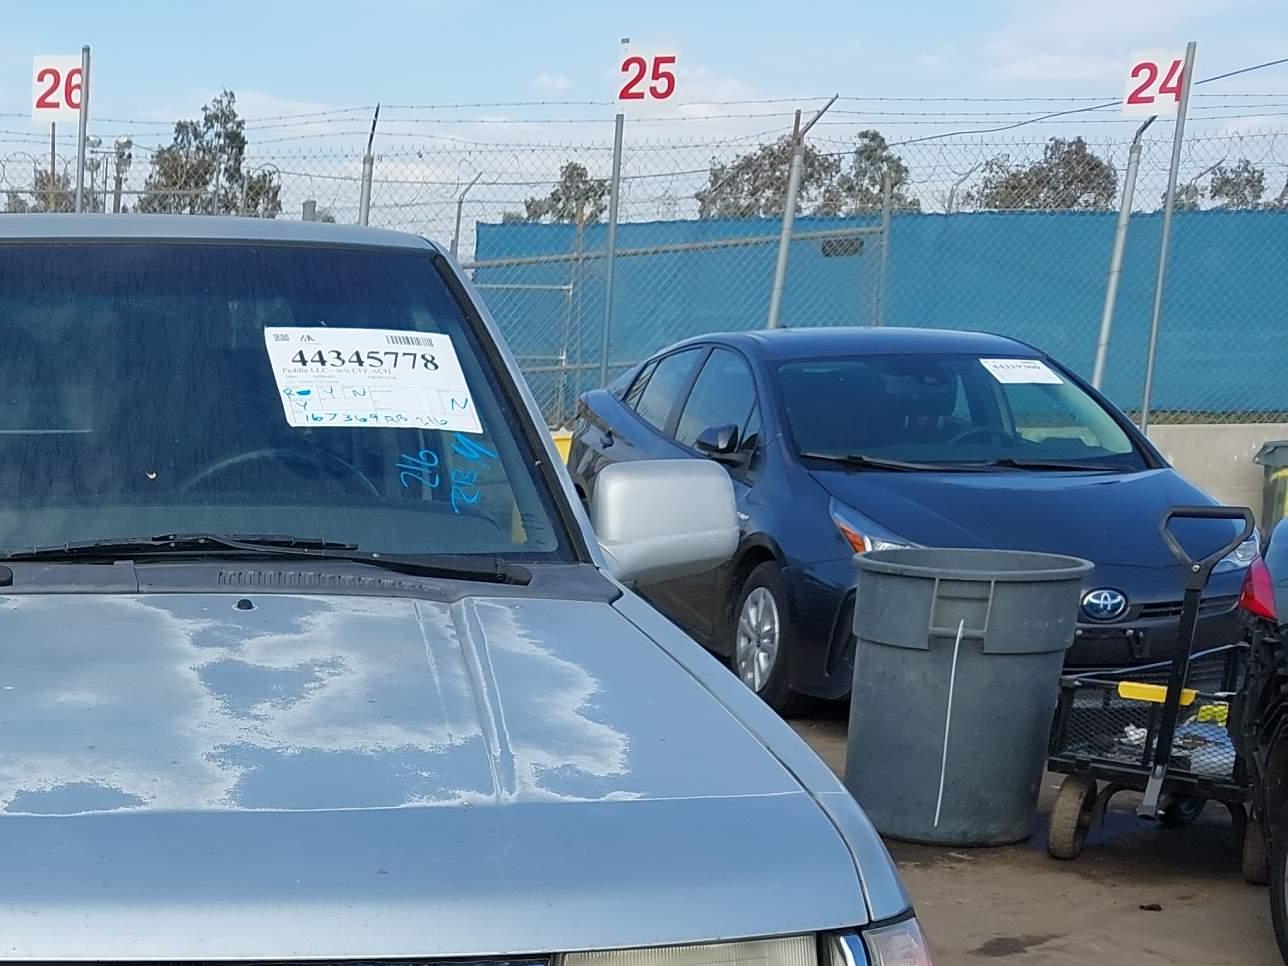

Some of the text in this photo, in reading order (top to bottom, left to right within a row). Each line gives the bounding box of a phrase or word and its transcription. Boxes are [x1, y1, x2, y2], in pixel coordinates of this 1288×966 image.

[35, 68, 81, 109] 26
[619, 56, 676, 100] 25
[1127, 60, 1183, 104] 24
[291, 349, 440, 371] 44345778
